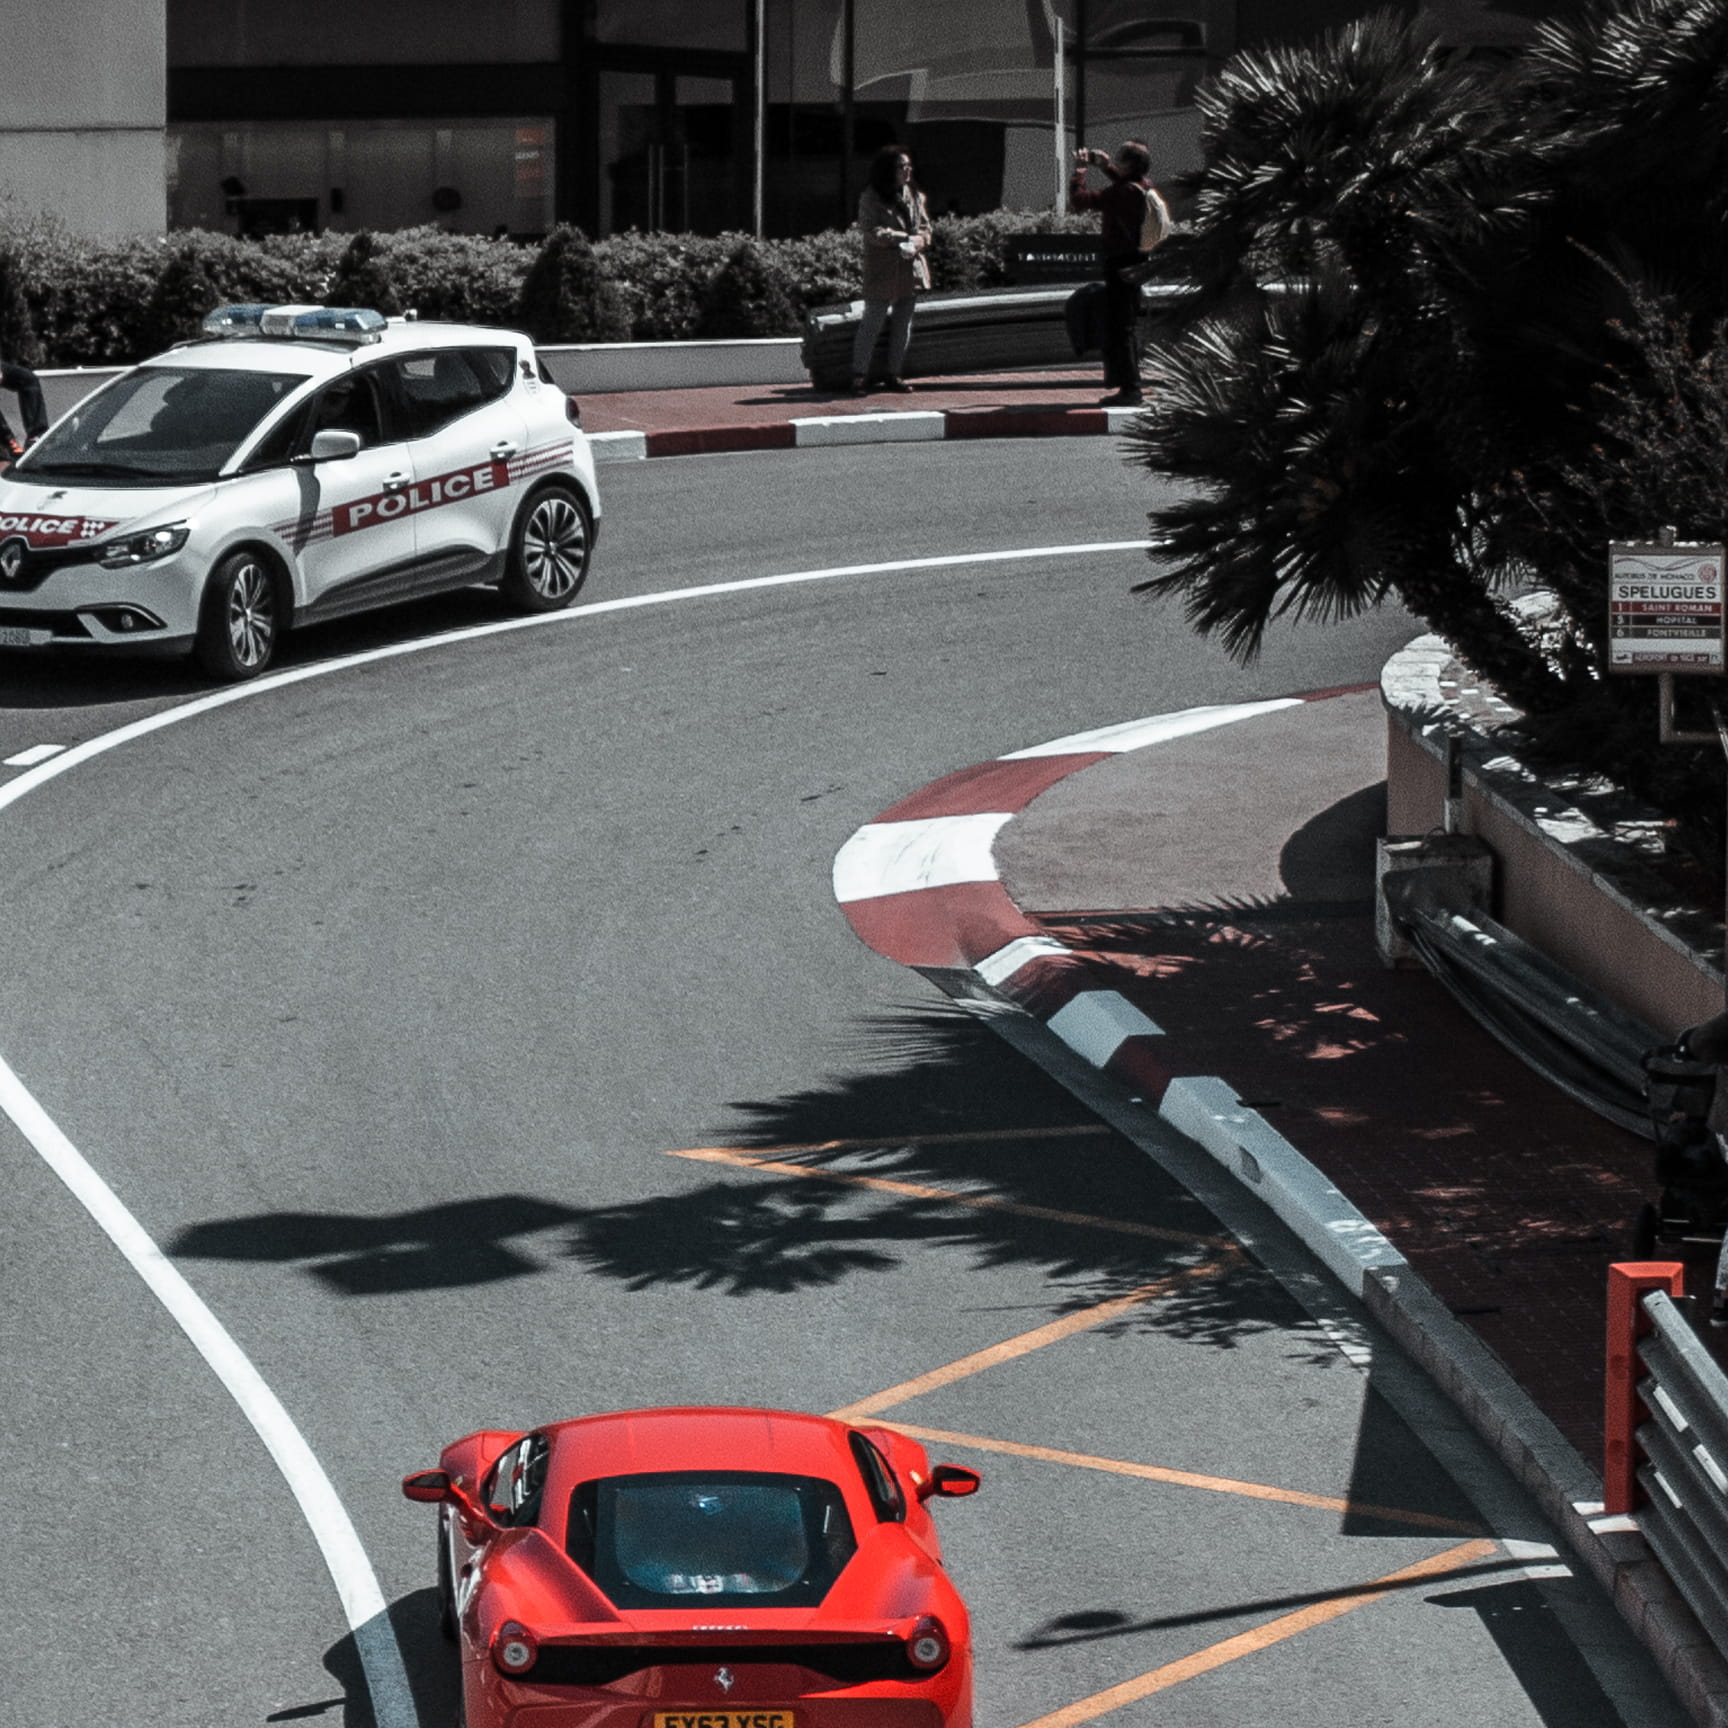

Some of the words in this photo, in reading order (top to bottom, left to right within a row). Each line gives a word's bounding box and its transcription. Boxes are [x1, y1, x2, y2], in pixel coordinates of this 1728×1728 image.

[348, 466, 494, 528] POLICE
[1618, 585, 1717, 600] SPELUGUES
[1642, 603, 1671, 612] SAINT
[1674, 604, 1713, 612] ROMAN
